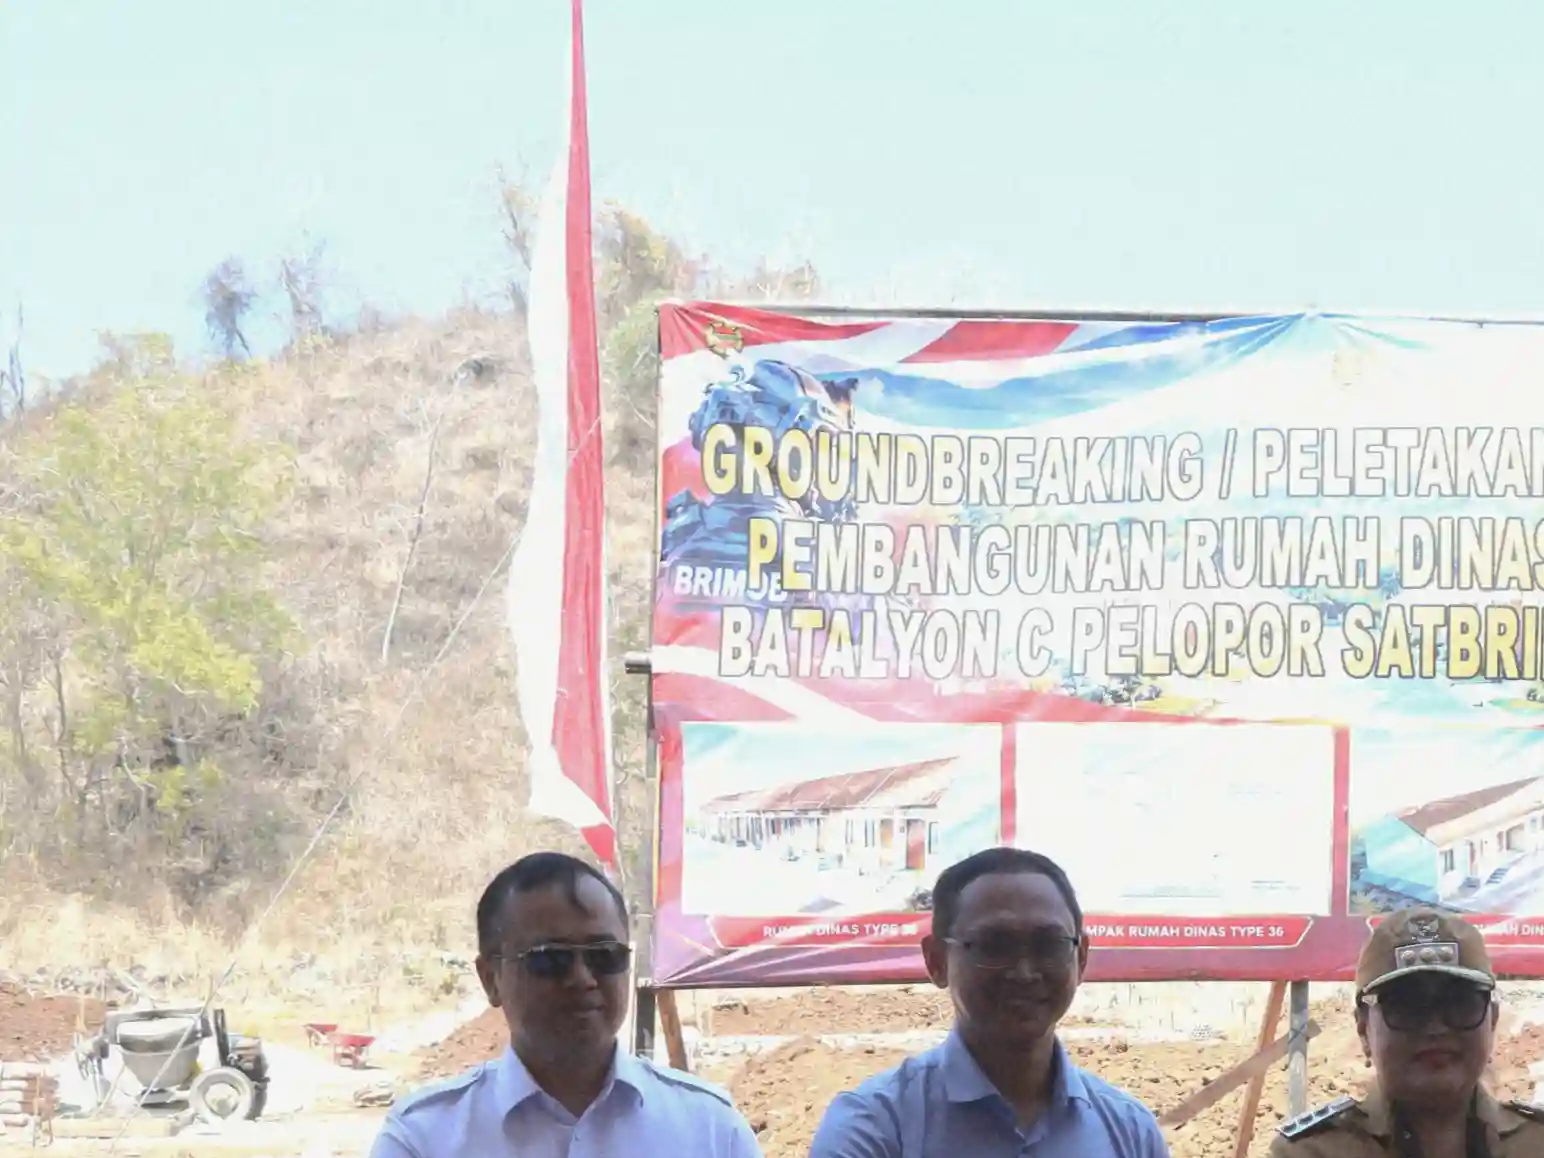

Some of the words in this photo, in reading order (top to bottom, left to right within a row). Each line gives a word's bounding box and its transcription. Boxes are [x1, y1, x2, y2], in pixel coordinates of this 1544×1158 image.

[702, 424, 1202, 505] GROUNDBREAKING
[1219, 428, 1238, 499] /
[747, 517, 1165, 596] PEMBANGUNAN
[1184, 516, 1380, 590] RUMAH
[718, 605, 1000, 679] BATALYON
[1016, 607, 1054, 677] C
[1071, 602, 1325, 679] PELOPOR
[1128, 925, 1179, 938] RUMAH
[1184, 924, 1226, 938] DINAS
[1230, 925, 1264, 938] TYPE
